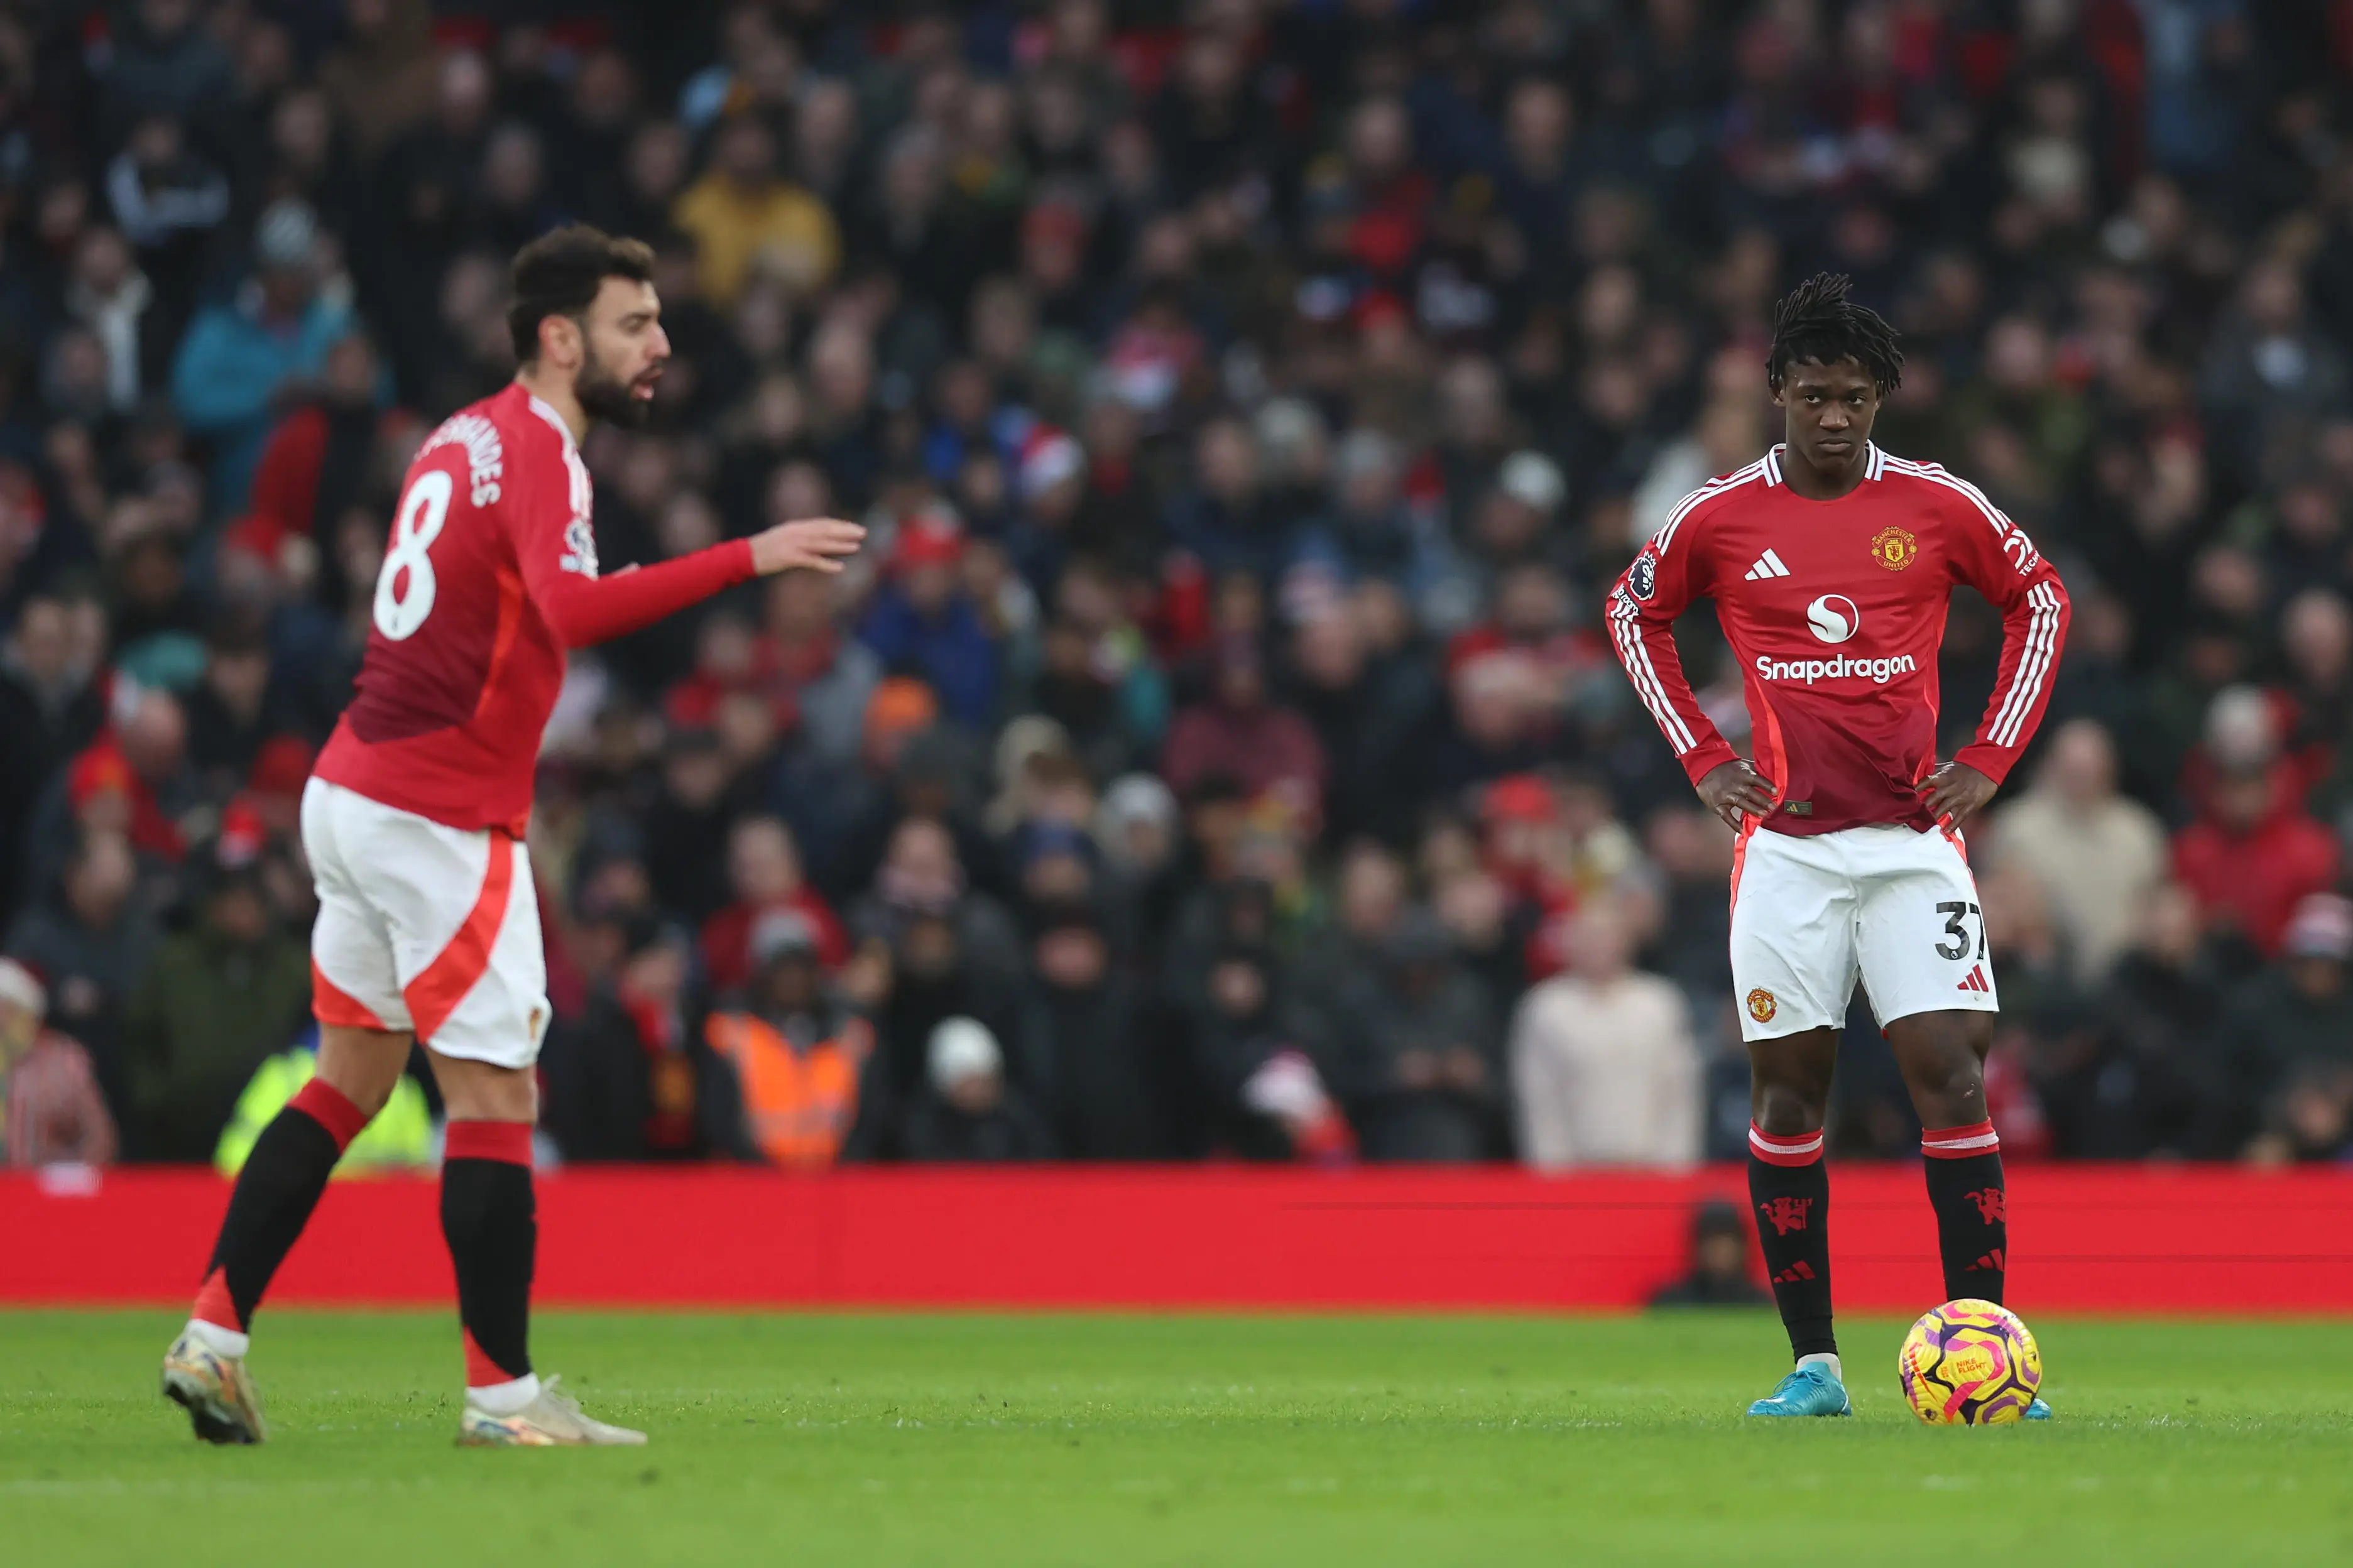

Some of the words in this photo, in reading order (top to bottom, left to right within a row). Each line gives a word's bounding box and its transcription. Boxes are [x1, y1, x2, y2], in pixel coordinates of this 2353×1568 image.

[1875, 530, 1912, 545] MANCHESTER
[373, 469, 453, 641] 8
[1884, 559, 1909, 567] UNITED
[1621, 594, 1639, 614] room
[1756, 654, 1916, 685] Snapdragon
[1935, 901, 1985, 960] 37
[1957, 1358, 1976, 1367] NIKE
[1958, 1362, 1986, 1374] FLIGHT
